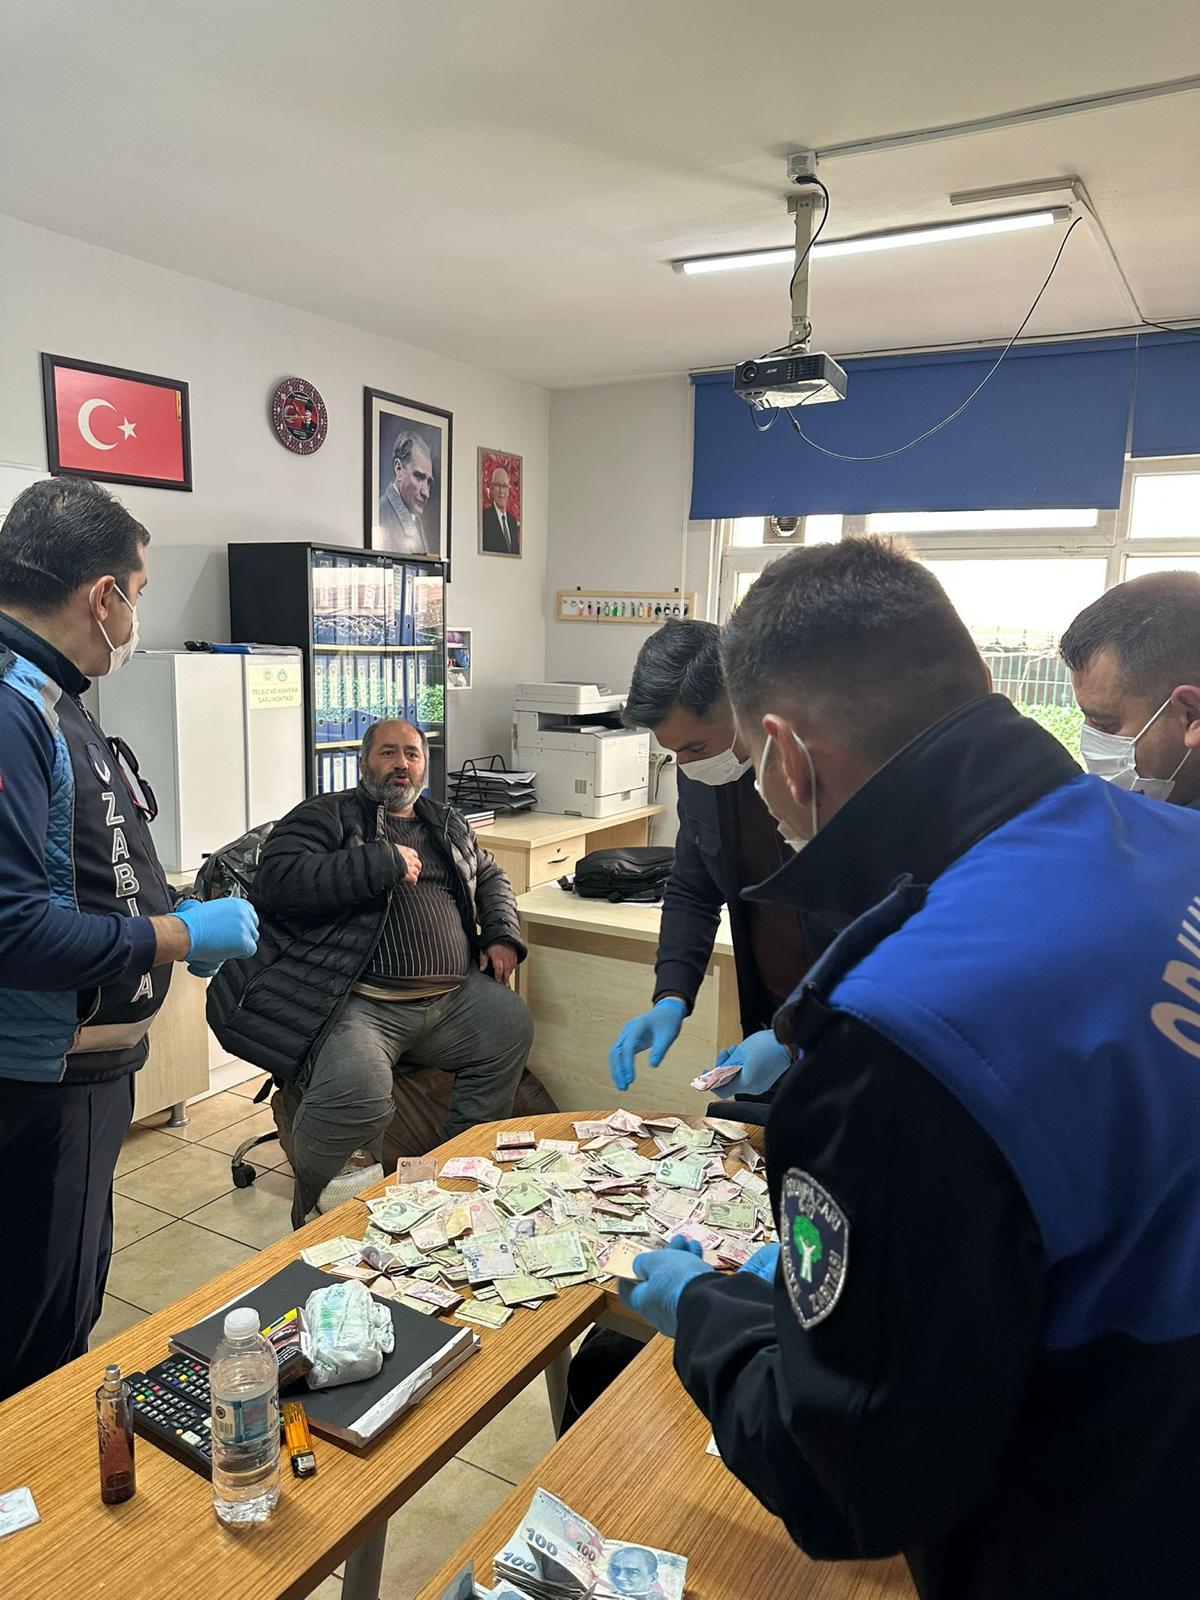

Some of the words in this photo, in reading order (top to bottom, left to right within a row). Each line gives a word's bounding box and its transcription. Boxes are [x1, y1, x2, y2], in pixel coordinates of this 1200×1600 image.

[102, 792, 154, 1003] ZABIA
[660, 1162, 674, 1177] 20
[736, 1221, 751, 1229] 20
[499, 1244, 509, 1254] 5
[526, 1527, 559, 1558] 100
[576, 1541, 597, 1562] 100
[503, 1552, 537, 1573] 100
